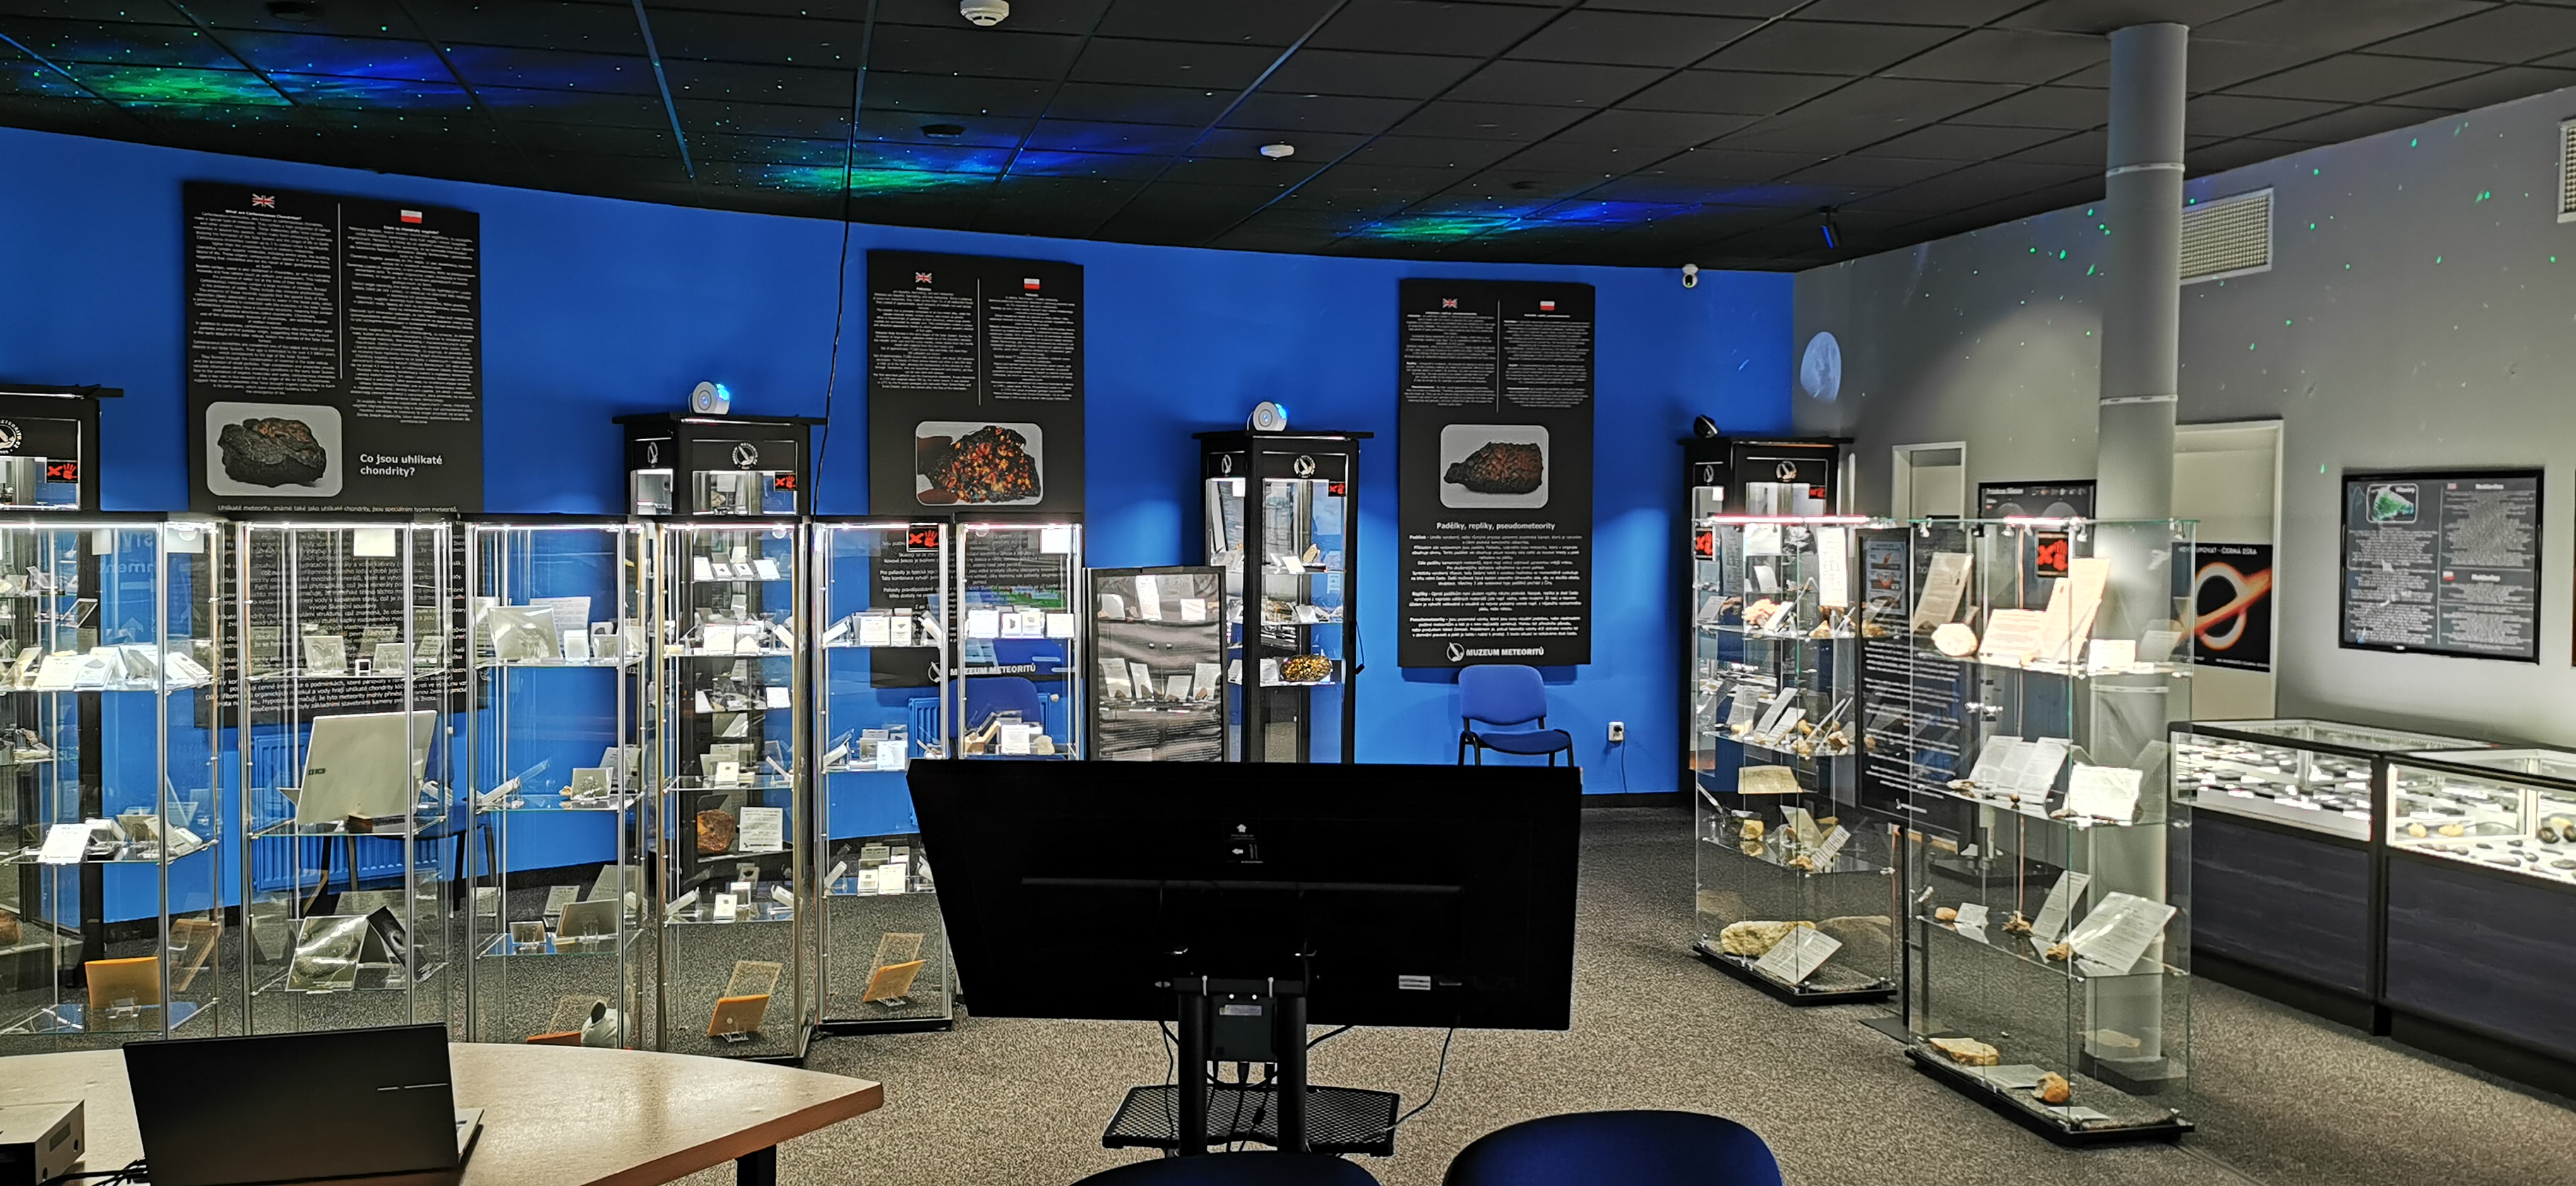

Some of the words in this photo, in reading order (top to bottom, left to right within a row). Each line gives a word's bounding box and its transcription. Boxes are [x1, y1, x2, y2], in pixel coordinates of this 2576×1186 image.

[360, 455, 374, 463] Co
[376, 455, 398, 465] jsou
[401, 455, 443, 465] uhlíkaté
[360, 466, 415, 477] chondrity?
[1501, 647, 1544, 655] METEORITŮ
